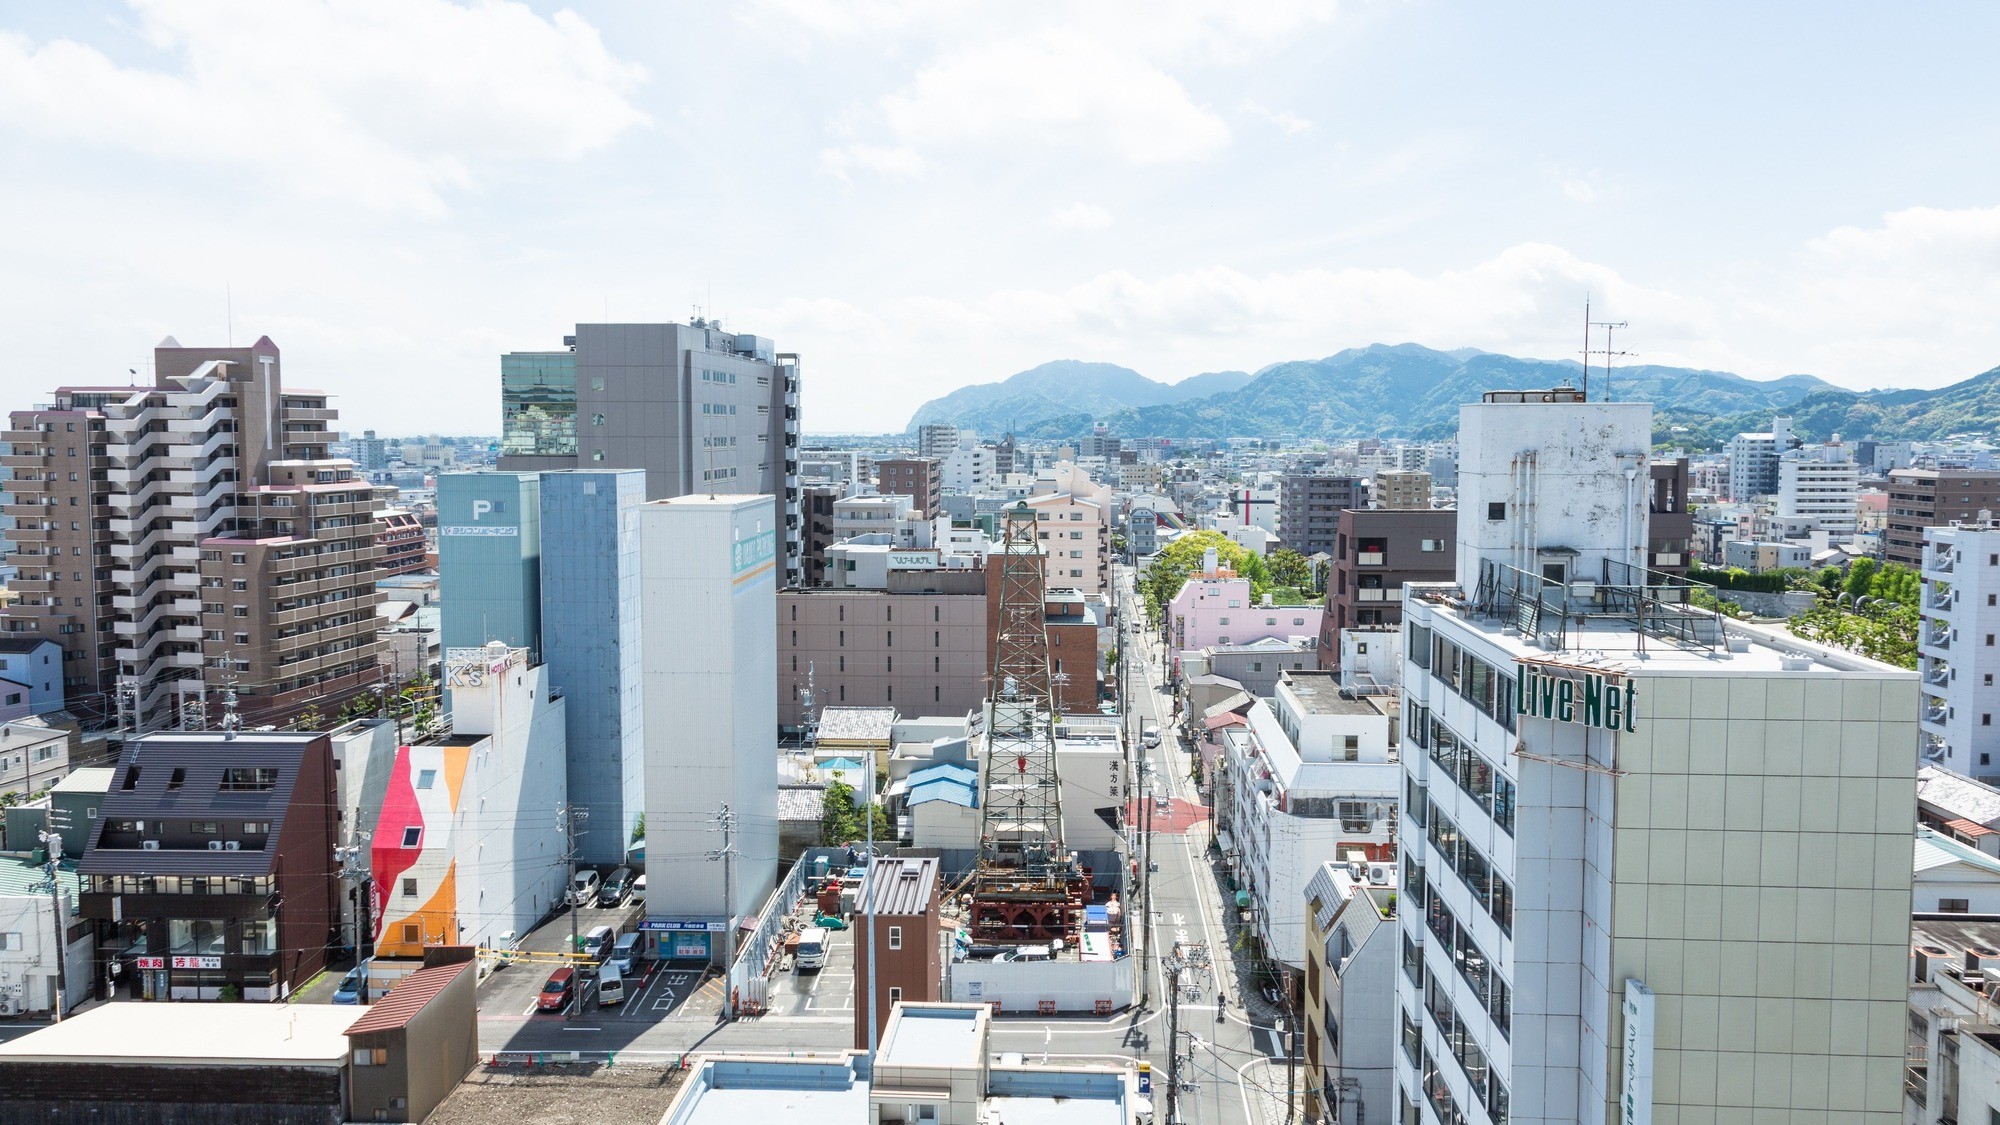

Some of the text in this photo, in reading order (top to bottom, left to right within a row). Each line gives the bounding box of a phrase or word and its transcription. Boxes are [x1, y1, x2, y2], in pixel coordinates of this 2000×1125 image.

[473, 500, 491, 520] P
[491, 661, 504, 675] HOTEL
[1518, 664, 1637, 734] Live Net
[1109, 761, 1119, 797] 漢方薬
[139, 958, 163, 968] 焼肉
[652, 975, 688, 1010] 出入口
[1140, 1077, 1149, 1088] P
